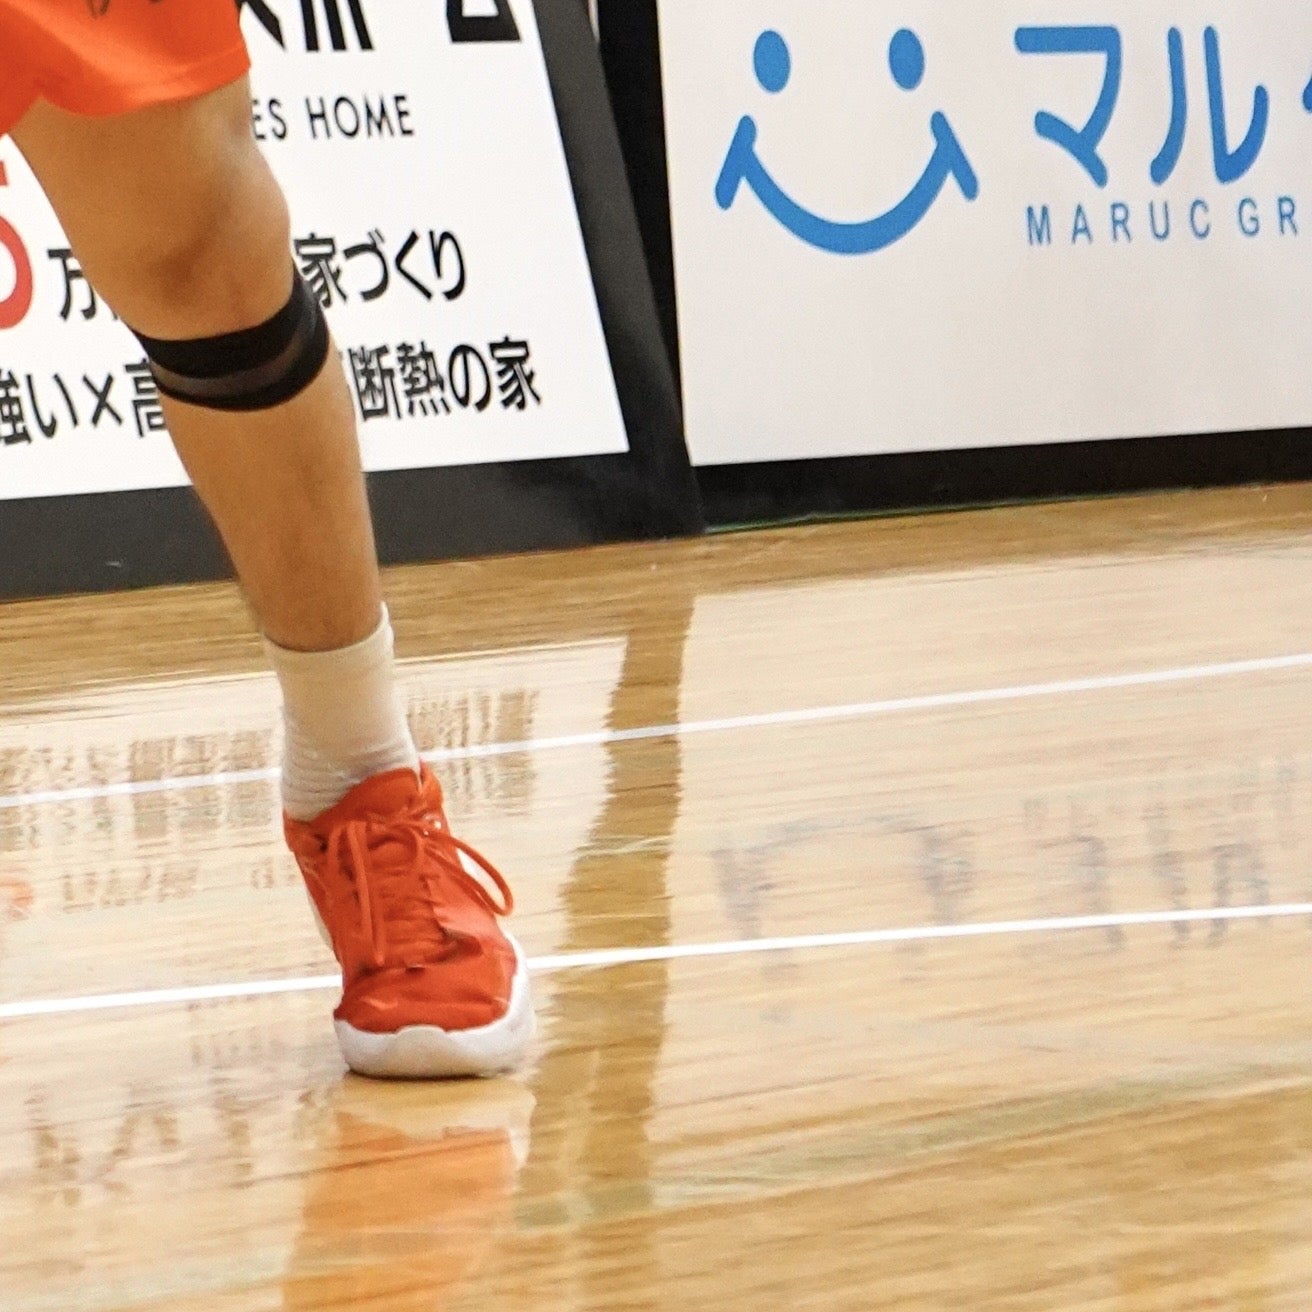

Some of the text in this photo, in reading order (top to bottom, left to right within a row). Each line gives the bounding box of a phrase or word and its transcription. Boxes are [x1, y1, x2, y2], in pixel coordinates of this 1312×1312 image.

[304, 94, 415, 141] HOME
[1014, 24, 1312, 189] マル
[1026, 195, 1299, 246] MARUC GR
